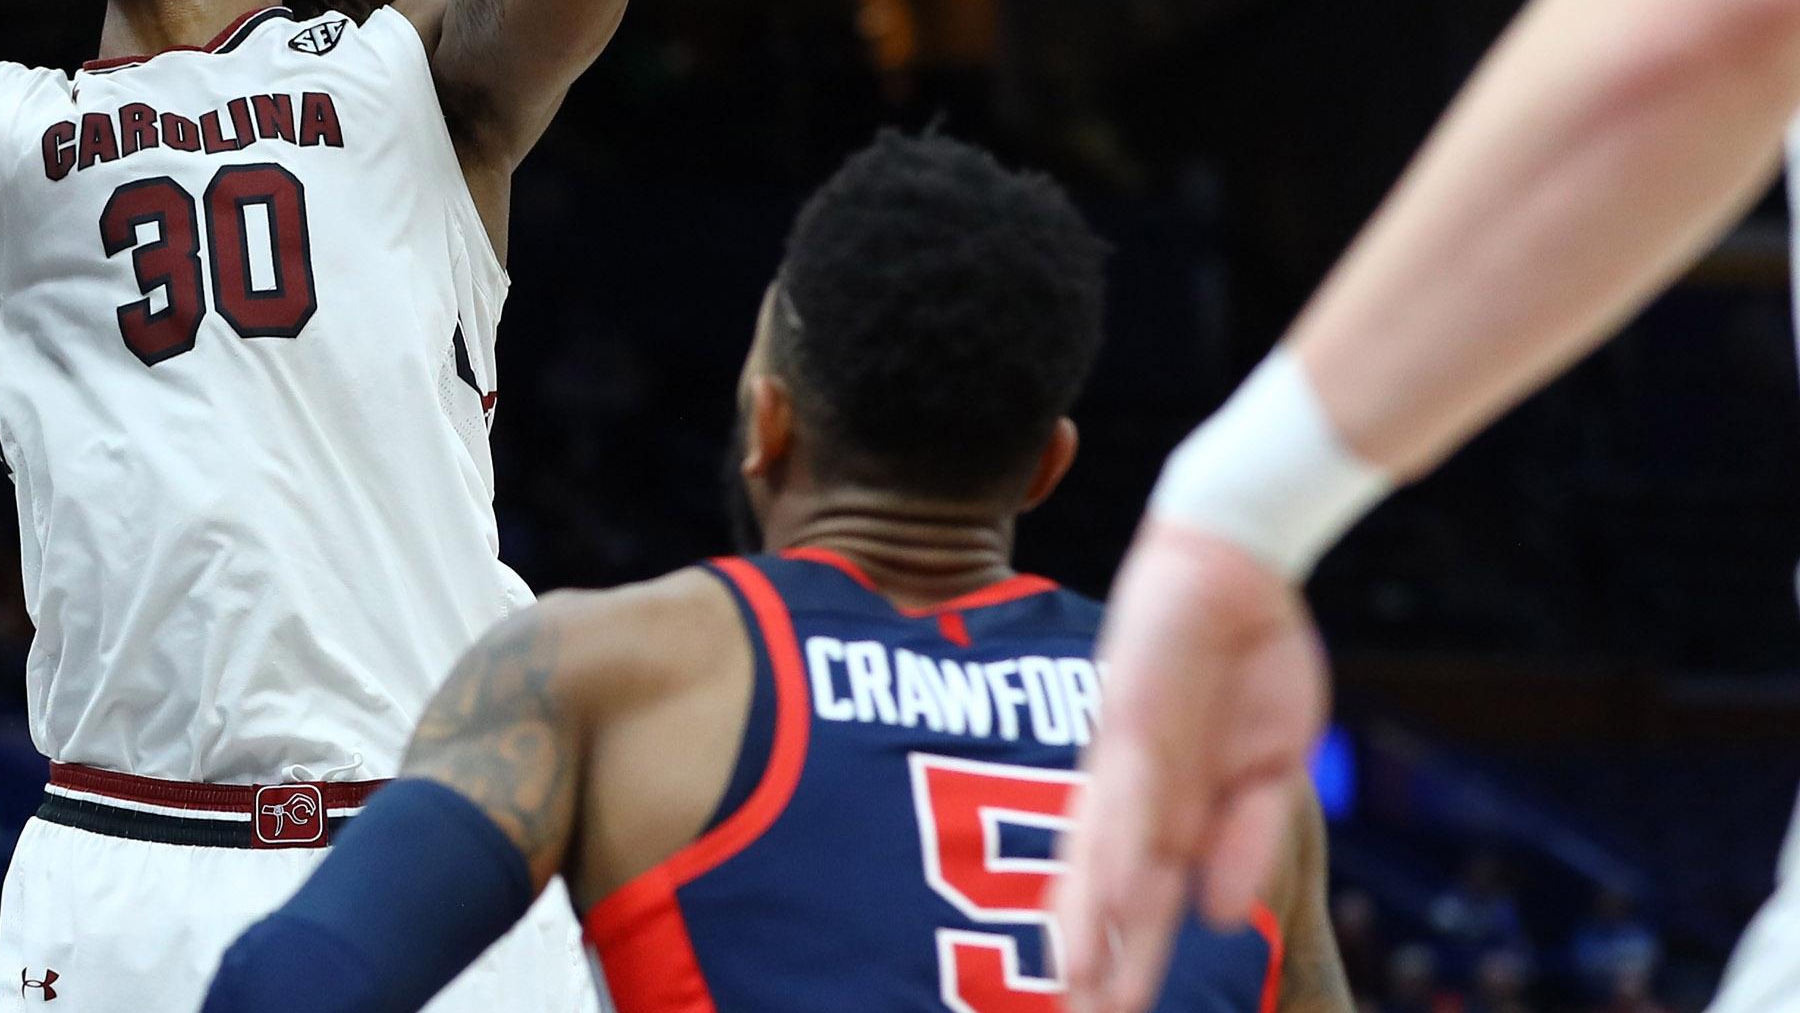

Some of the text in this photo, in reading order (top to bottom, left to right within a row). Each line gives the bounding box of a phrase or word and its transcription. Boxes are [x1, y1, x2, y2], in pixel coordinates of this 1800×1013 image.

[290, 20, 347, 54] SEC
[42, 91, 344, 182] CAROLINA
[99, 162, 317, 368] 30
[805, 635, 1112, 746] CRAWFOR
[907, 751, 1092, 1013] 5
